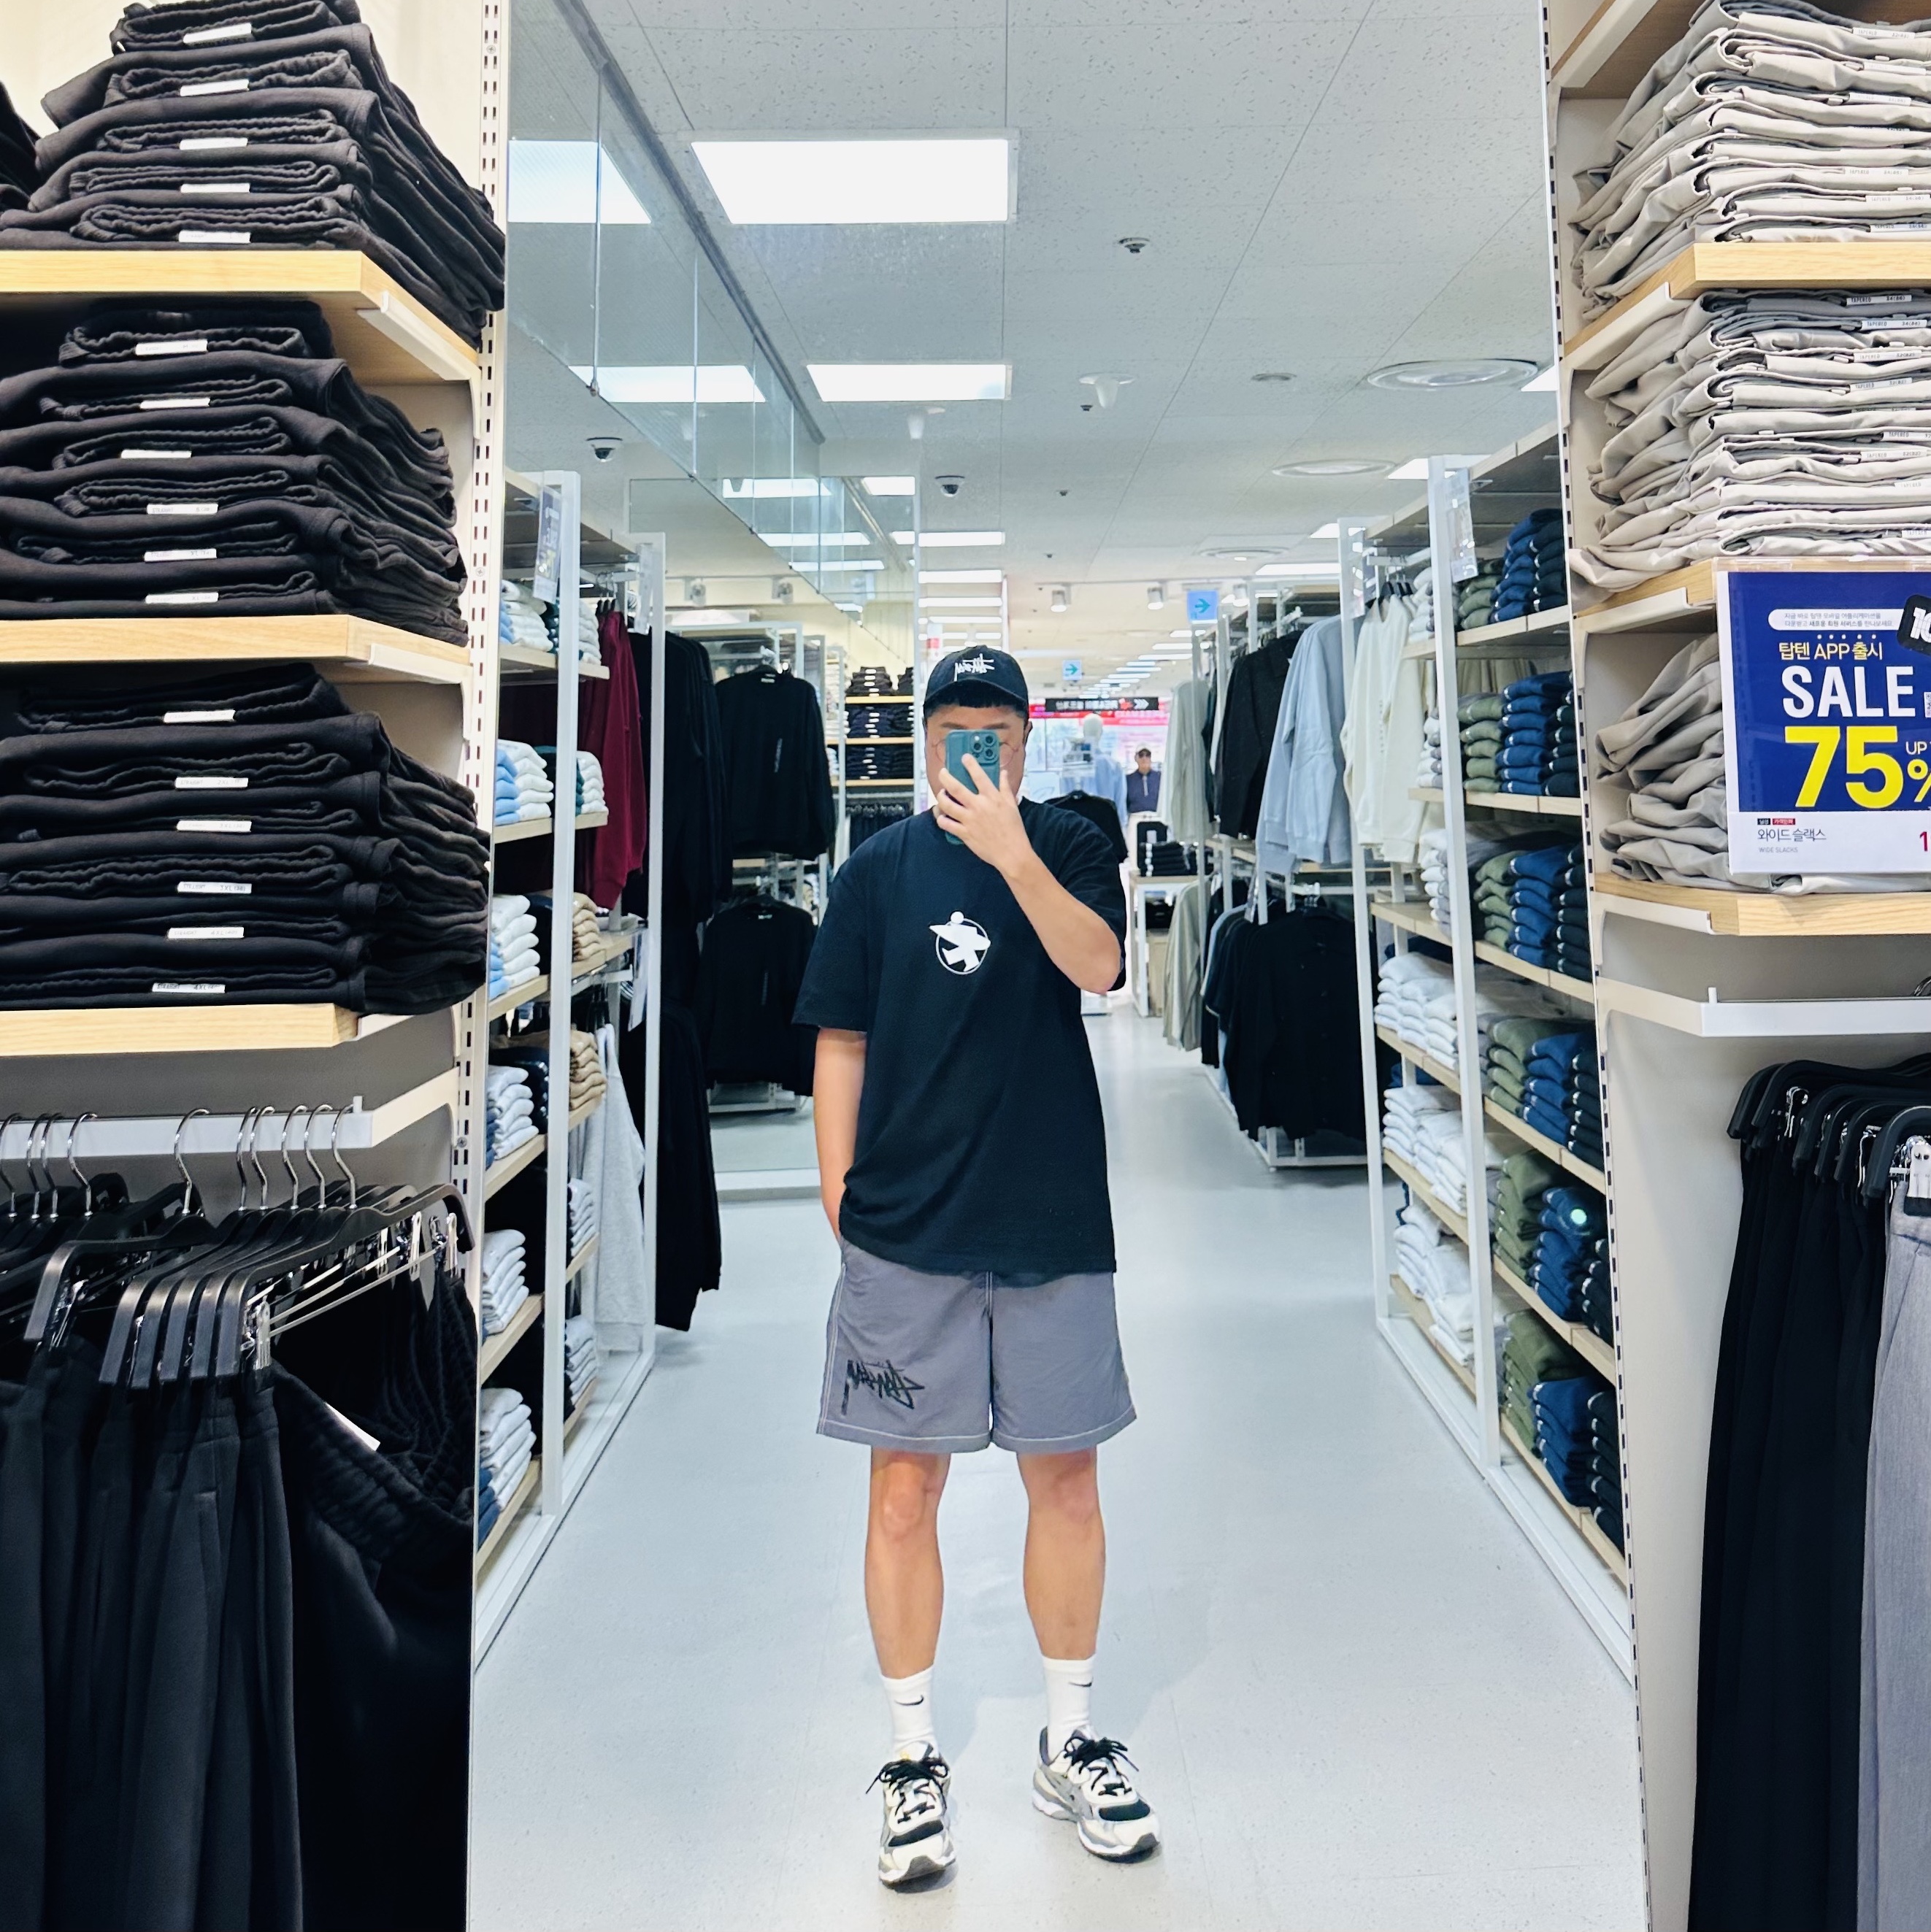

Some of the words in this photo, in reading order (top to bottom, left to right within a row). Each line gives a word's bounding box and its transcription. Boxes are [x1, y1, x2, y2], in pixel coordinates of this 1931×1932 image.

[1779, 642, 1810, 661] 탑텐
[1813, 643, 1850, 661] APP
[1851, 642, 1883, 661] 출시
[1782, 665, 1916, 718] SALE
[1905, 741, 1927, 755] UP
[1758, 828, 1792, 842] 와이드
[1792, 828, 1827, 842] 슬랙스
